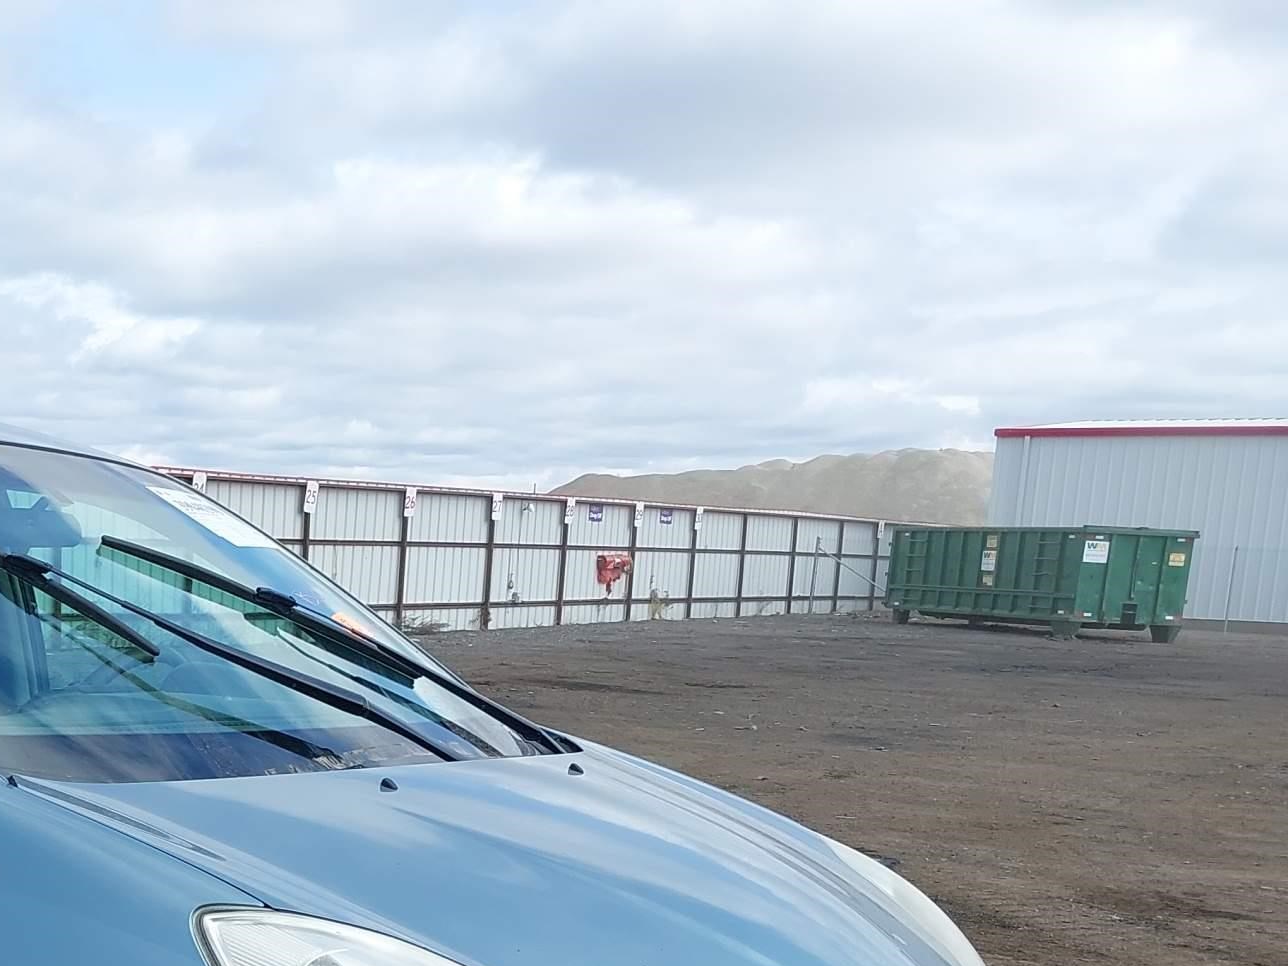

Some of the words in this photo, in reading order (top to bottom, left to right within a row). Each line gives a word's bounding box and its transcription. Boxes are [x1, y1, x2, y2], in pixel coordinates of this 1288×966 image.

[306, 489, 316, 505] 25
[405, 496, 416, 509] 26
[492, 501, 502, 513] 27
